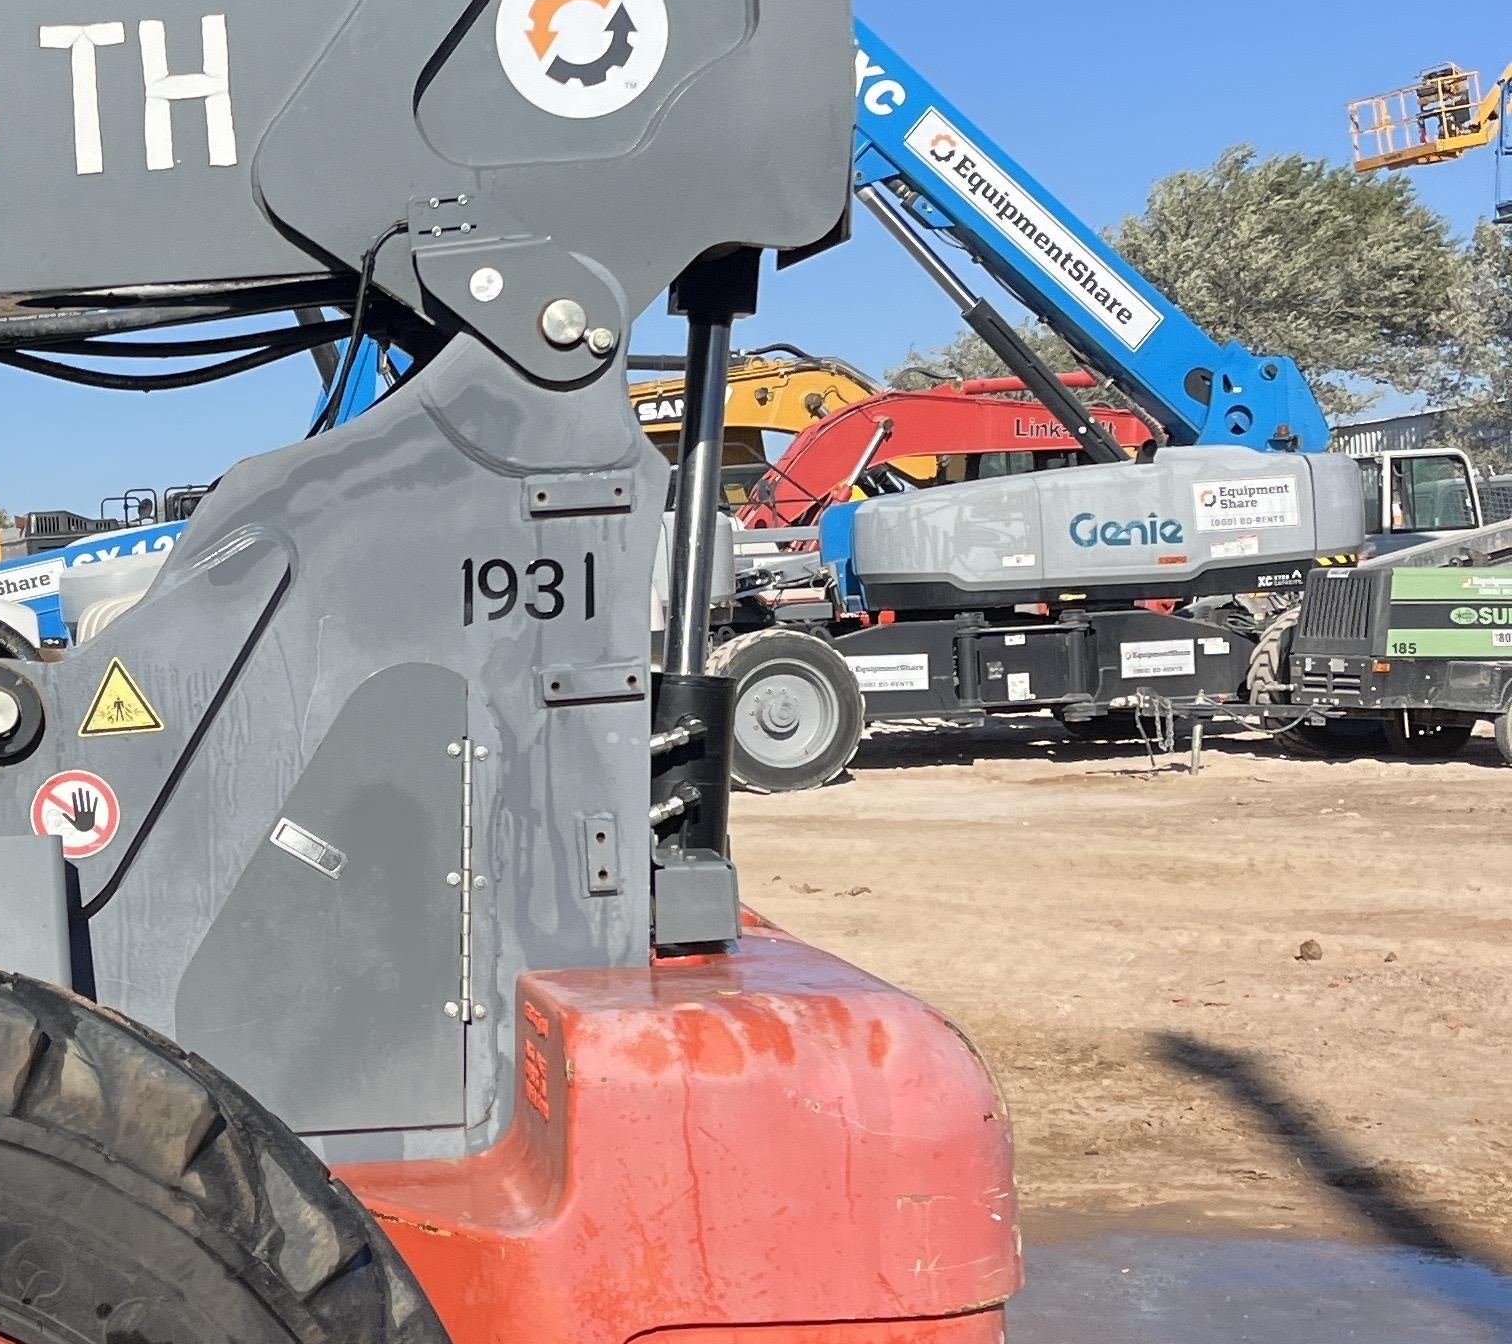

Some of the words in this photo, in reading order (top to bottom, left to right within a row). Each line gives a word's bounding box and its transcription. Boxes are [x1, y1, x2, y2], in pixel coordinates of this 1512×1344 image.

[38, 14, 237, 176] TH
[952, 155, 1134, 326] EquipmentShare
[1219, 484, 1289, 497] Equipment
[1220, 498, 1258, 509] Share
[1069, 512, 1184, 548] Genie
[461, 552, 595, 627] 1931
[1478, 607, 1512, 625] SU
[1391, 642, 1417, 655] 185
